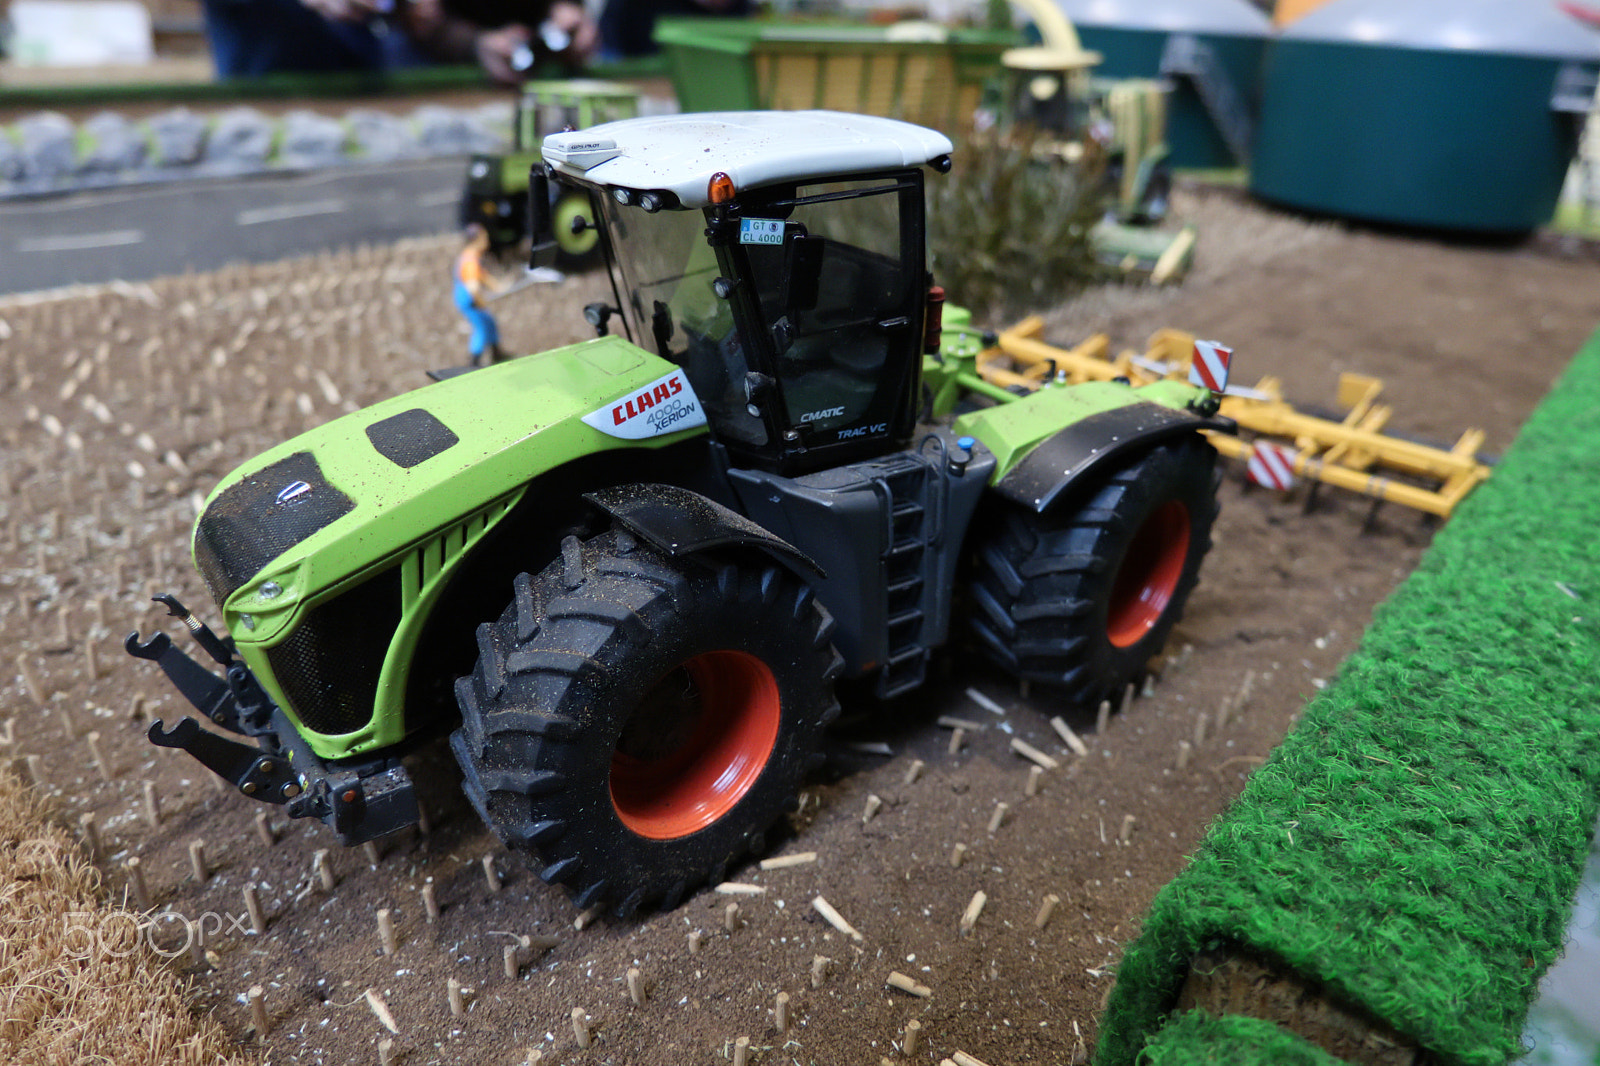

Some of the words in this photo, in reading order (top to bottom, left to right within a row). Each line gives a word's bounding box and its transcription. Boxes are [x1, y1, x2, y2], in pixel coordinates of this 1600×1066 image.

[753, 221, 765, 230] GT
[743, 233, 755, 241] CL
[758, 234, 782, 243] 4000
[612, 376, 682, 426] CLAAS
[646, 399, 682, 424] 4000
[654, 402, 695, 433] XERION
[800, 406, 845, 423] CMATIC
[838, 426, 867, 439] TRAC
[869, 423, 887, 433] VC
